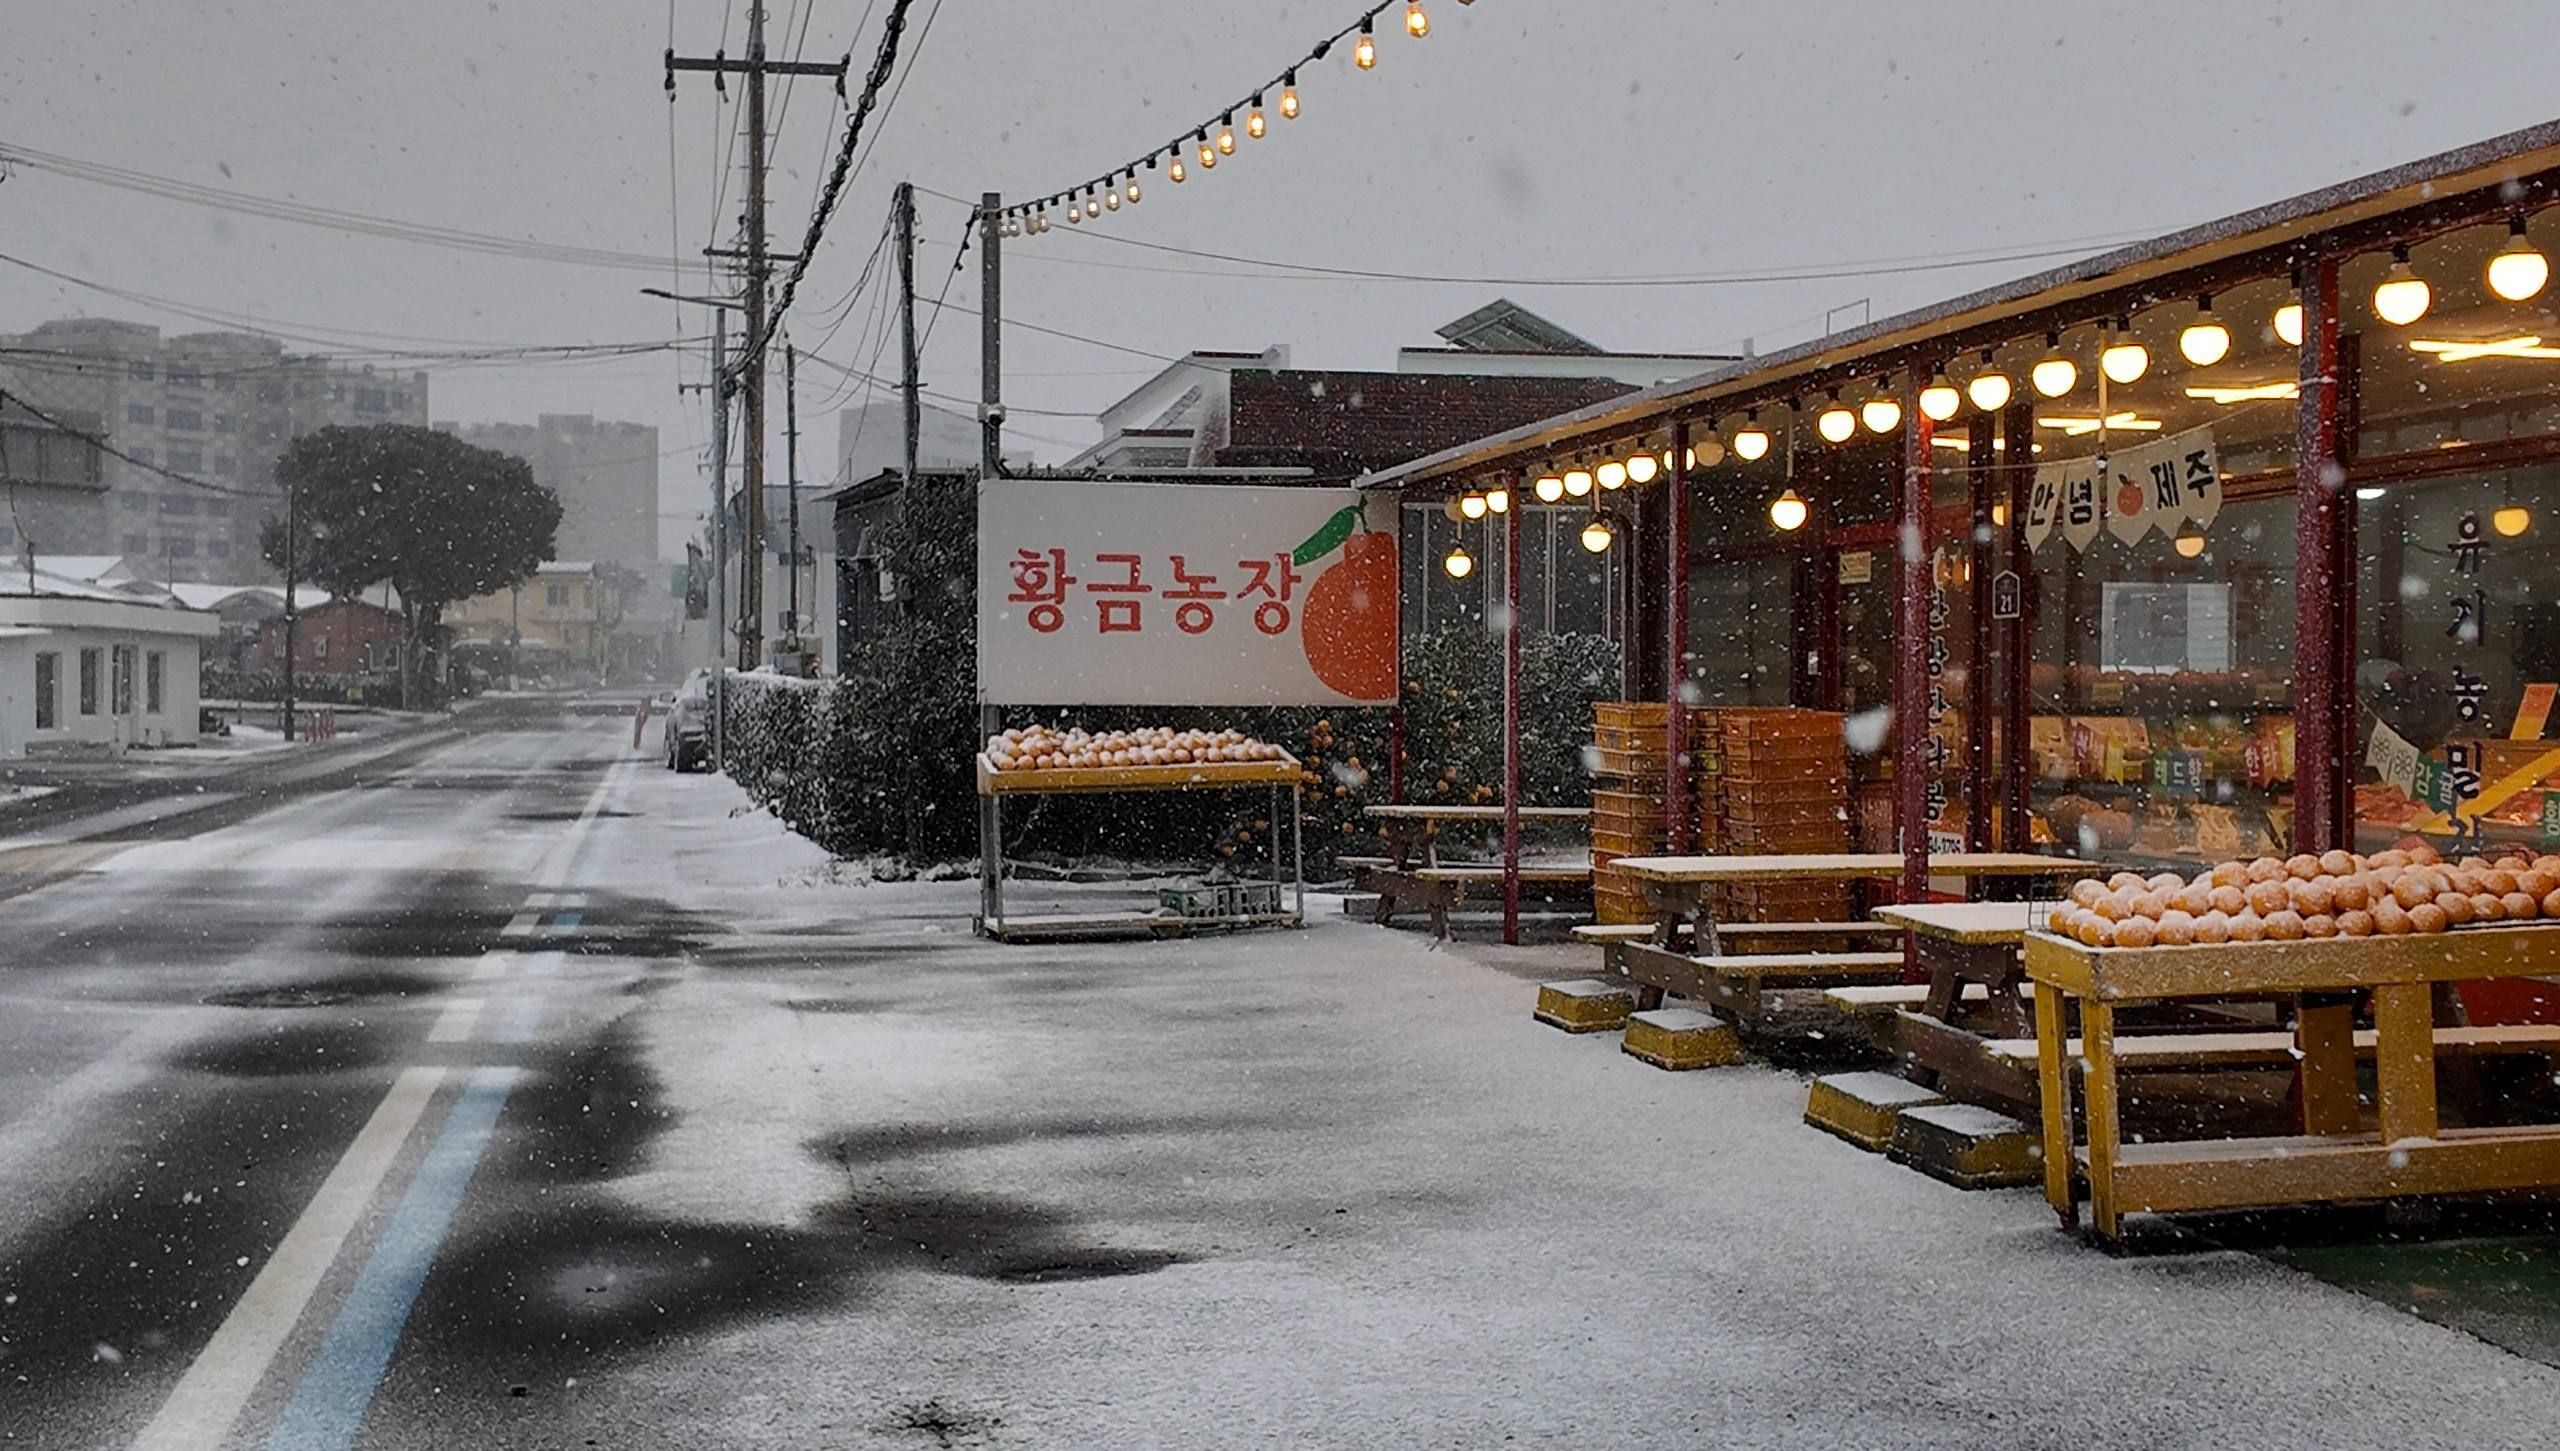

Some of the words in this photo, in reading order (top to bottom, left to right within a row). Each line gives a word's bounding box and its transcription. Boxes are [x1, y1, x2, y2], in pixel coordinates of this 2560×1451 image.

[2030, 478, 2093, 527] 안녕
[2150, 448, 2215, 510] 제주
[1007, 547, 1303, 636] 황금농장
[2000, 594, 2012, 613] 21
